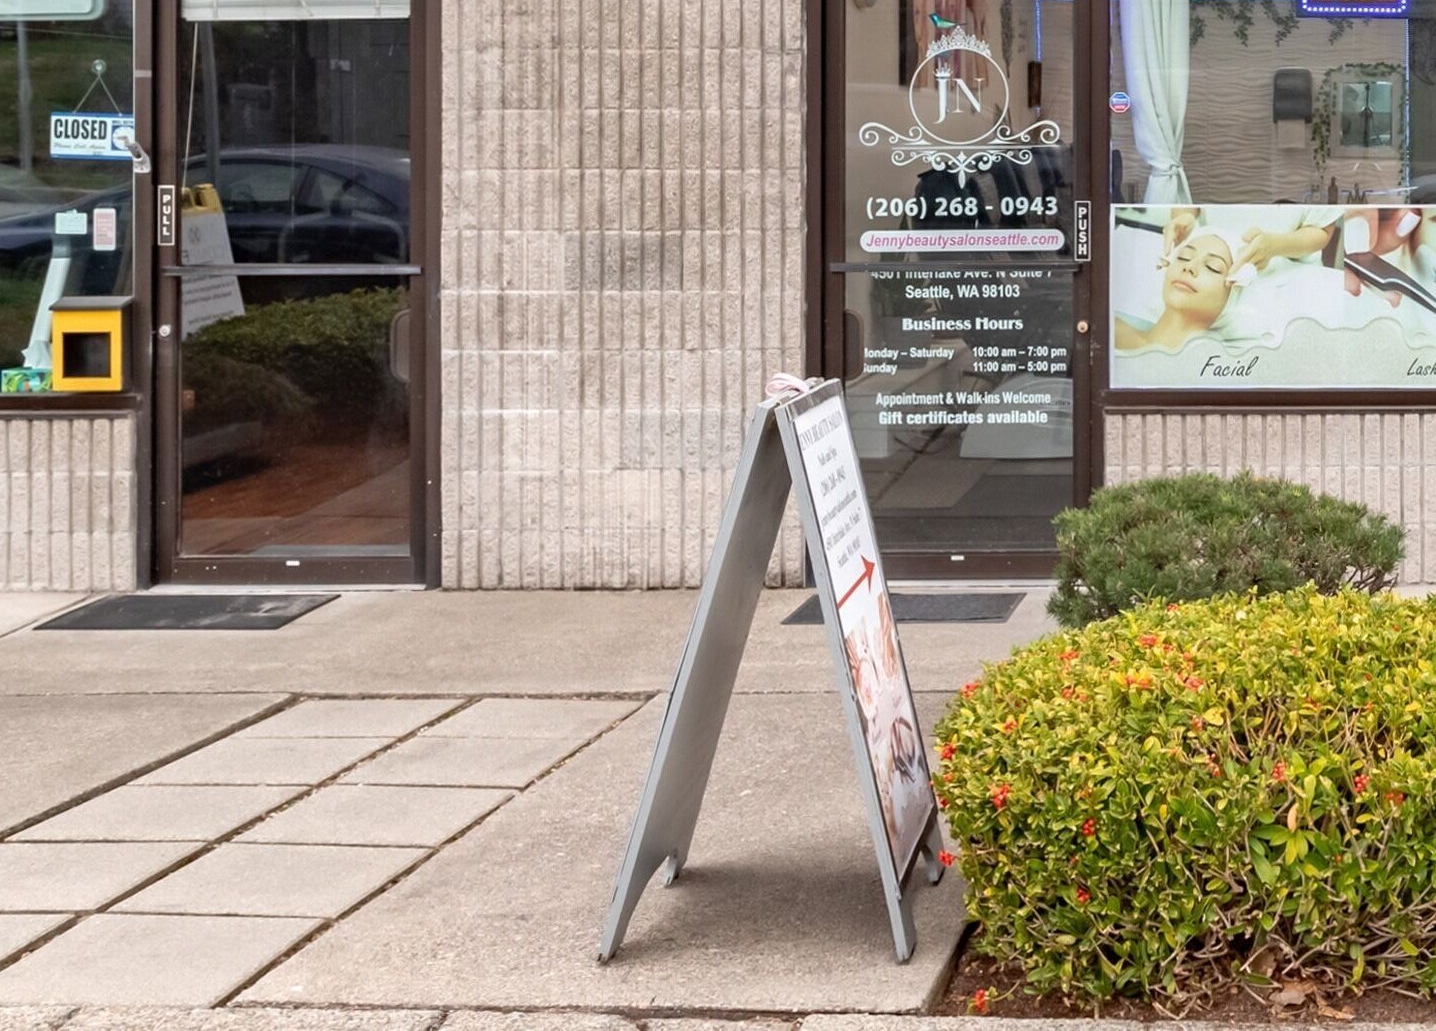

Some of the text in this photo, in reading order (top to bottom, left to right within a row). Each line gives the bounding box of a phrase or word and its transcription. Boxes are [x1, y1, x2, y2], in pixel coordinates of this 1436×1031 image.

[53, 118, 108, 141] CLOSED
[162, 194, 171, 236] PULL
[866, 196, 927, 219] (206)
[934, 196, 978, 217] 268
[1000, 195, 1059, 216] 0943
[1078, 206, 1088, 255] PUSH
[866, 233, 1059, 250] Jennybeautysalonseattle.com
[905, 284, 1020, 300] Seattle, WA 98103
[902, 316, 1024, 331] Business Hours
[864, 347, 899, 360] onday
[909, 347, 954, 359] Saturday
[972, 346, 999, 357] 10:00
[1001, 348, 1016, 357] am
[1027, 345, 1048, 357] 7:00
[1051, 348, 1067, 360] pm
[972, 361, 999, 372] 11:00
[1001, 363, 1016, 372] am
[1027, 361, 1048, 372] 5:00
[1051, 363, 1067, 375] pm
[1199, 355, 1259, 378] Facial
[875, 391, 1052, 407] Appointment & Walk-ins Welcome
[878, 409, 1048, 425] Gift certificates available
